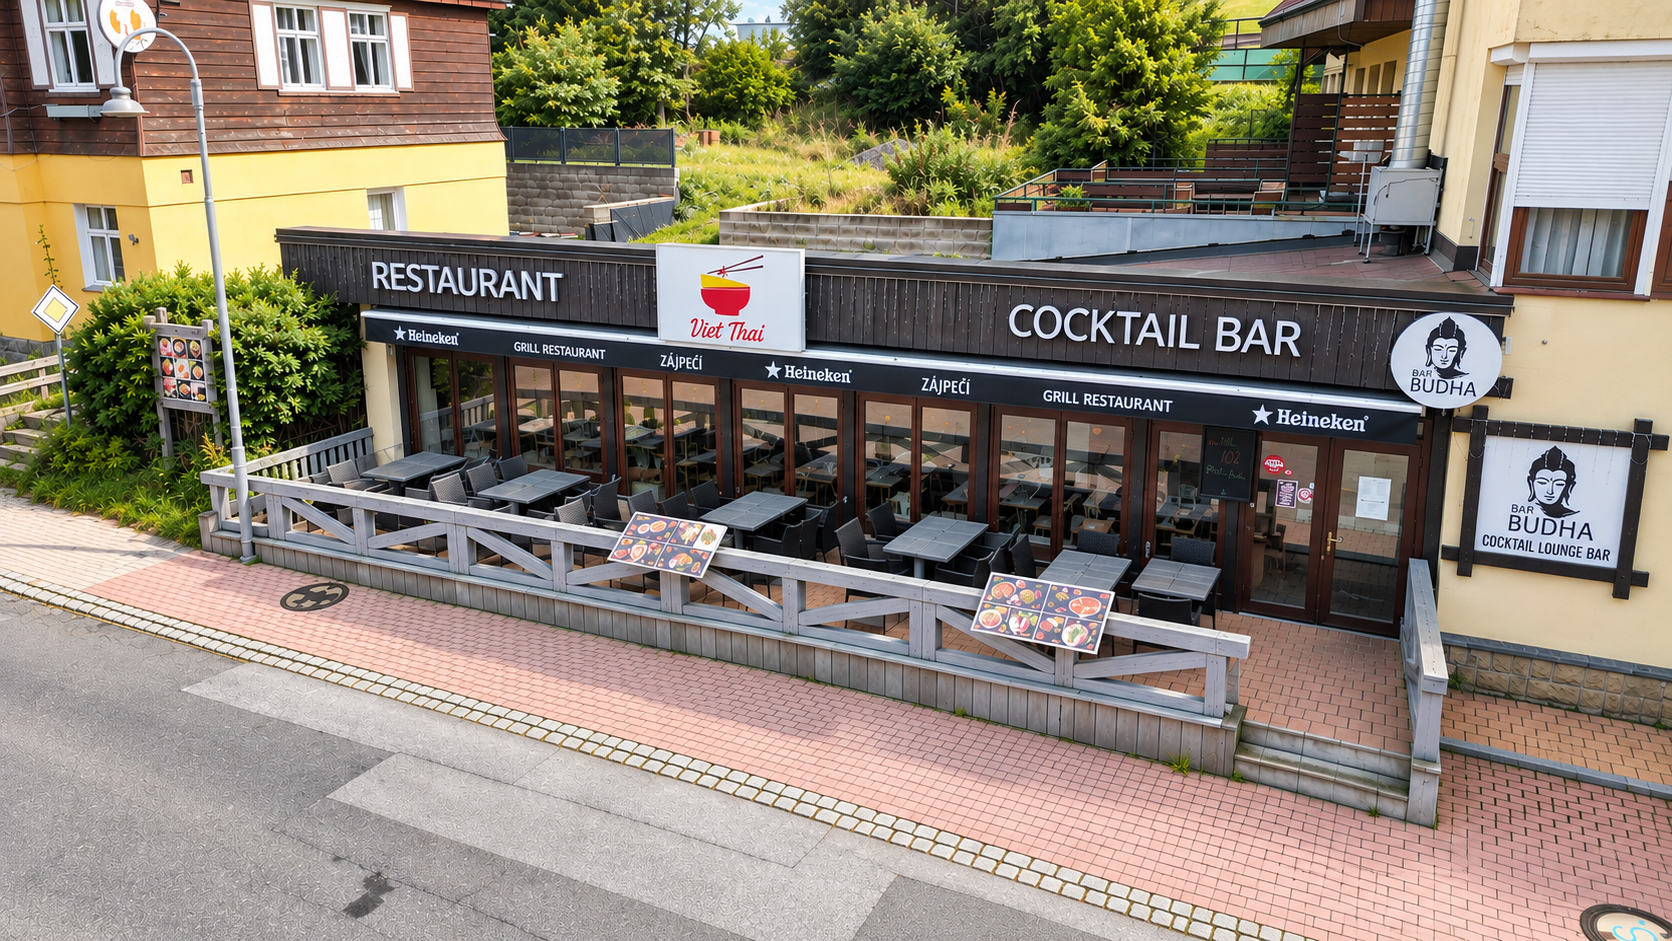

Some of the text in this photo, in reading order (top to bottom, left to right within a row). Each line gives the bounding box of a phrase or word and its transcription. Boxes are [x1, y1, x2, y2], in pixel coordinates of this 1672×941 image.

[371, 261, 564, 302] RESTAURANT
[407, 328, 459, 346] Heineken
[690, 317, 765, 342] Viet Thai
[1008, 303, 1301, 357] COCKTAIL BAR
[513, 341, 606, 360] GRILL RESTAURANT
[784, 364, 852, 384] Heineken
[1411, 369, 1433, 378] BAR
[1410, 377, 1477, 397] BUDHA
[1043, 390, 1173, 413] GRILL RESTAURANT
[1275, 408, 1370, 432] Heineken
[1511, 504, 1534, 514] BAR
[1508, 514, 1593, 541] BUDHA
[1482, 534, 1611, 562] COCKTAIL LOUNGE BAR
